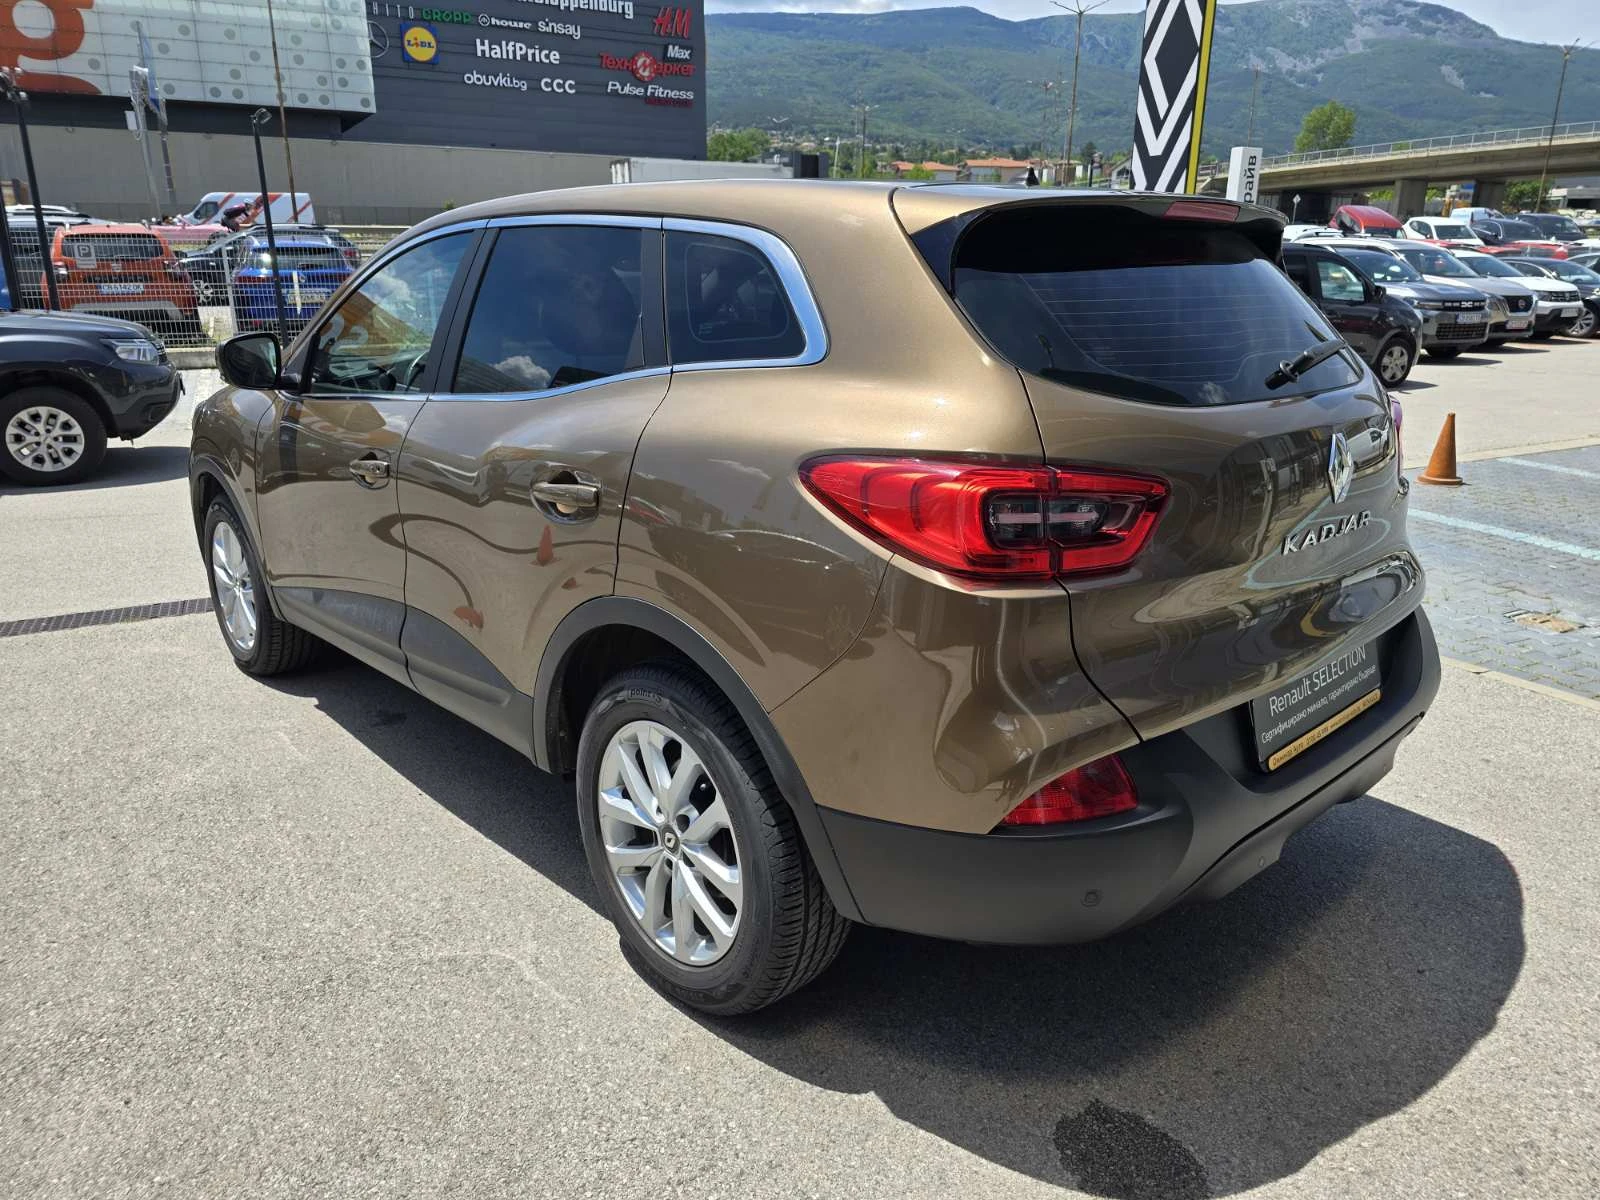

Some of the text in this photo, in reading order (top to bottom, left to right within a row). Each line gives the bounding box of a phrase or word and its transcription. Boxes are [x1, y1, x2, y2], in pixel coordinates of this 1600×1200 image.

[652, 6, 692, 39] H&M
[475, 38, 560, 65] HalfPrice
[667, 44, 691, 60] Max
[463, 70, 528, 91] obuvki.bg
[540, 78, 576, 94] CCC
[607, 80, 694, 100] Pulse Fitness
[1281, 509, 1373, 556] KADJAR
[1269, 674, 1311, 717] Renault
[1312, 643, 1367, 691] SELECTION
